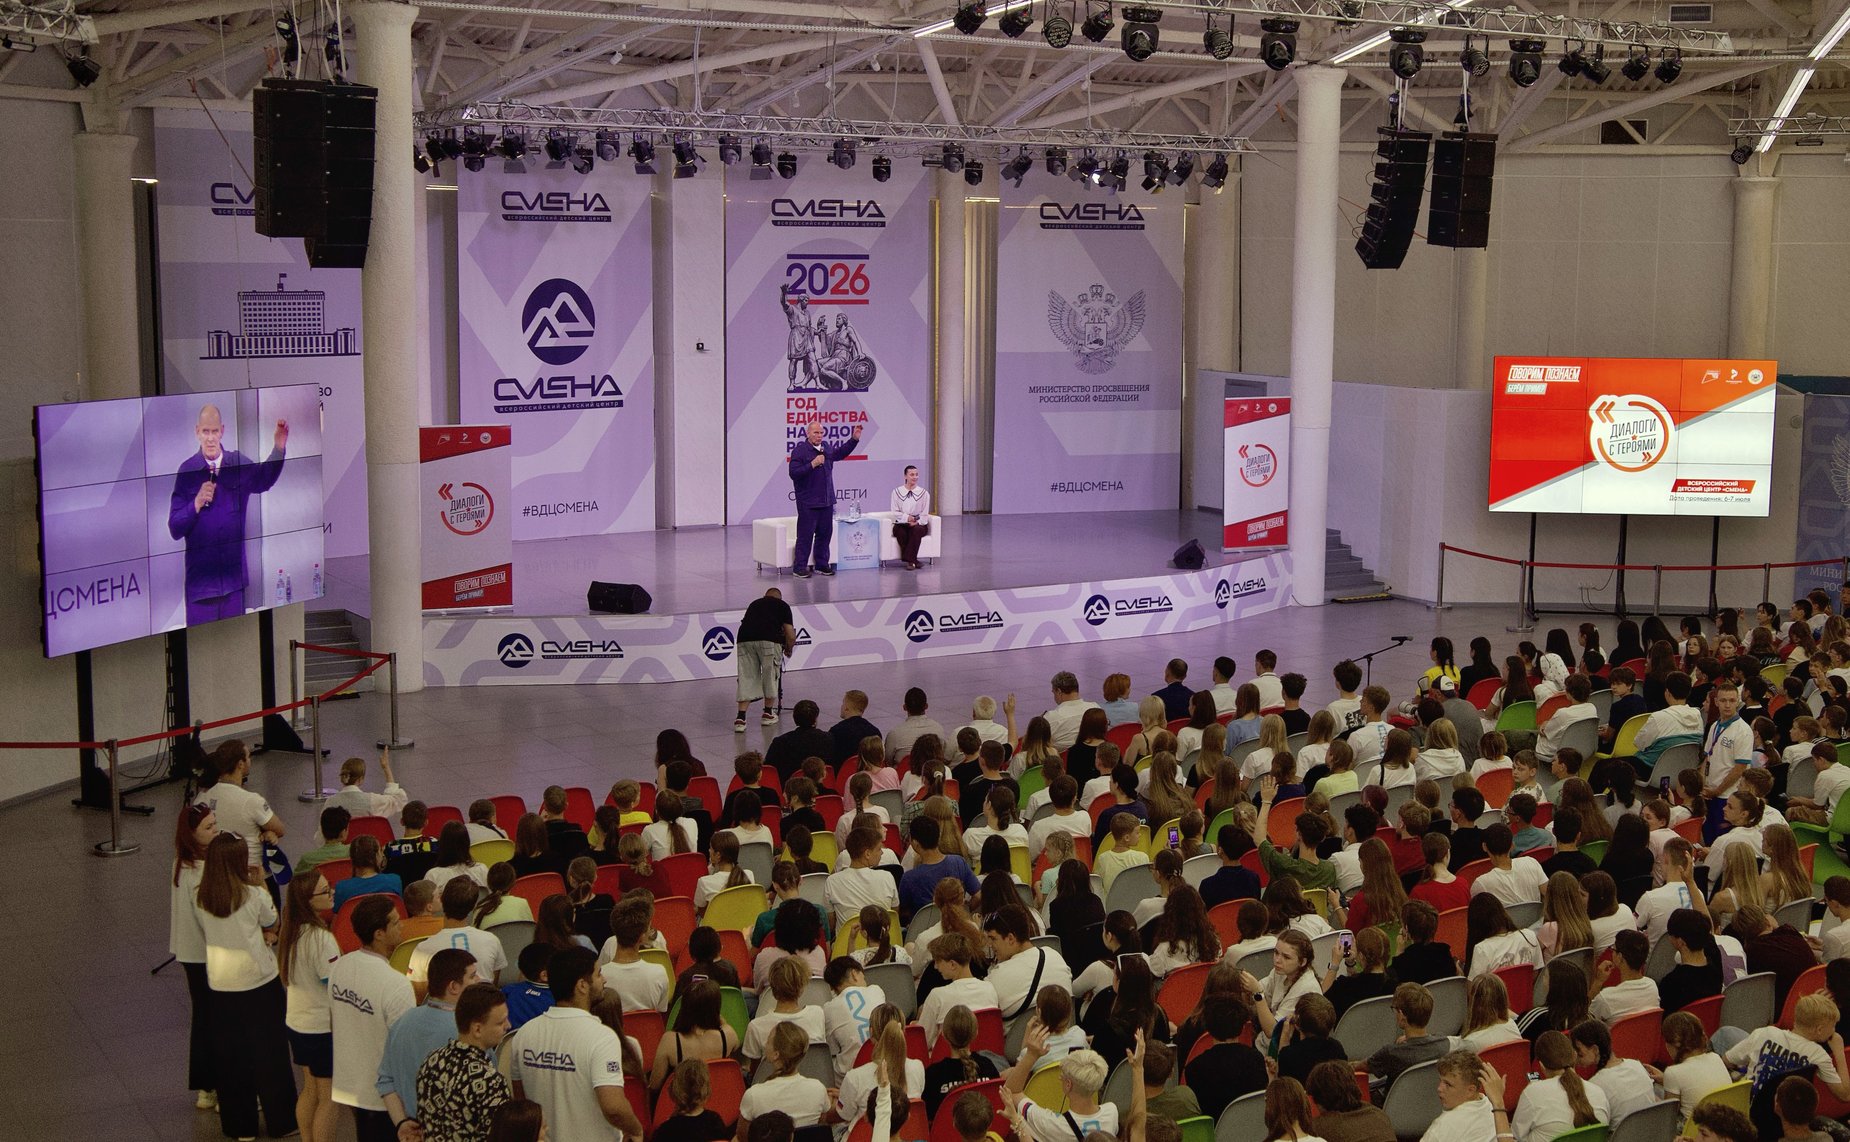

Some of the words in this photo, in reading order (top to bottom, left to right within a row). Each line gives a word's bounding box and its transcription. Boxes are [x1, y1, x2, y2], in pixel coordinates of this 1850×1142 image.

[501, 191, 611, 212] СМЕНА
[771, 198, 886, 217] СМЕНА
[1040, 202, 1145, 220] СМЕНА
[786, 262, 870, 295] 2026
[494, 374, 623, 401] СМЕНА
[1028, 385, 1091, 394] МИНИСТЕРСТВО
[1092, 384, 1150, 393] ПРОСВЕЩЕНИЯ
[500, 402, 560, 412] всероссийский
[562, 401, 594, 409] детский
[786, 397, 818, 411] ГОД
[1039, 394, 1091, 403] РОССИЙСКОЙ
[1092, 394, 1140, 402] ФЕДЕРАЦИИ
[786, 411, 869, 425] ЕДИНСТВА
[1610, 418, 1657, 439] ДИАЛОГИ
[1609, 444, 1615, 456] С
[1617, 438, 1657, 455] ГЕРОЯМИ
[1050, 481, 1124, 494] #ВДЦСМЕНА
[450, 494, 485, 512] ДИАЛОГИ
[522, 500, 599, 518] #ВДЦСМЕНА
[450, 515, 455, 525] С
[456, 509, 486, 524] ГЕРОЯМИ
[1115, 595, 1173, 611] СМЕНА
[940, 611, 1004, 627] СМЕНА
[541, 640, 623, 653] СМЕНА
[523, 1049, 575, 1066] СМЕНА
